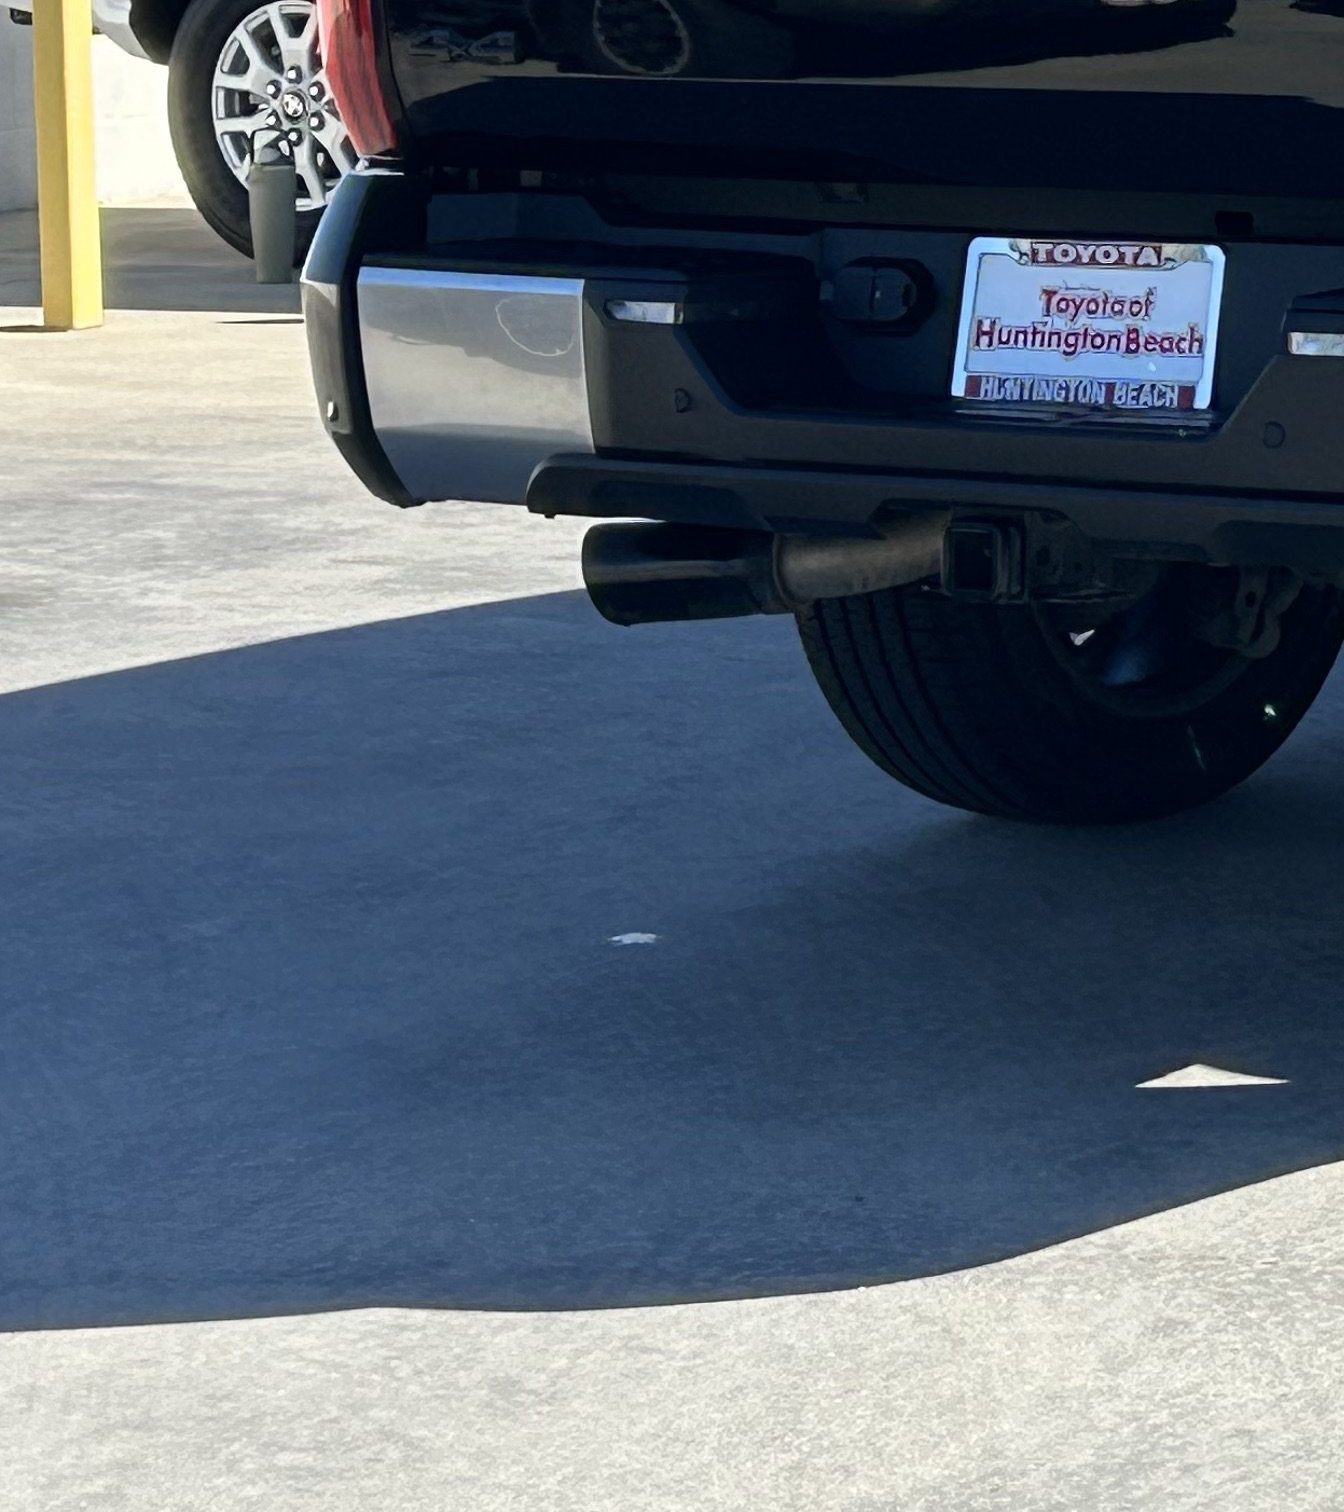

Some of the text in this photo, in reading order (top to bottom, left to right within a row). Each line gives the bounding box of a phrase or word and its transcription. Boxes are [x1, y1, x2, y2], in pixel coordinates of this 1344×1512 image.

[1030, 242, 1161, 266] TOYOTA
[1040, 286, 1155, 322] Toyota of
[974, 316, 1204, 358] Huntington Beach
[1111, 384, 1179, 410] BEACH
